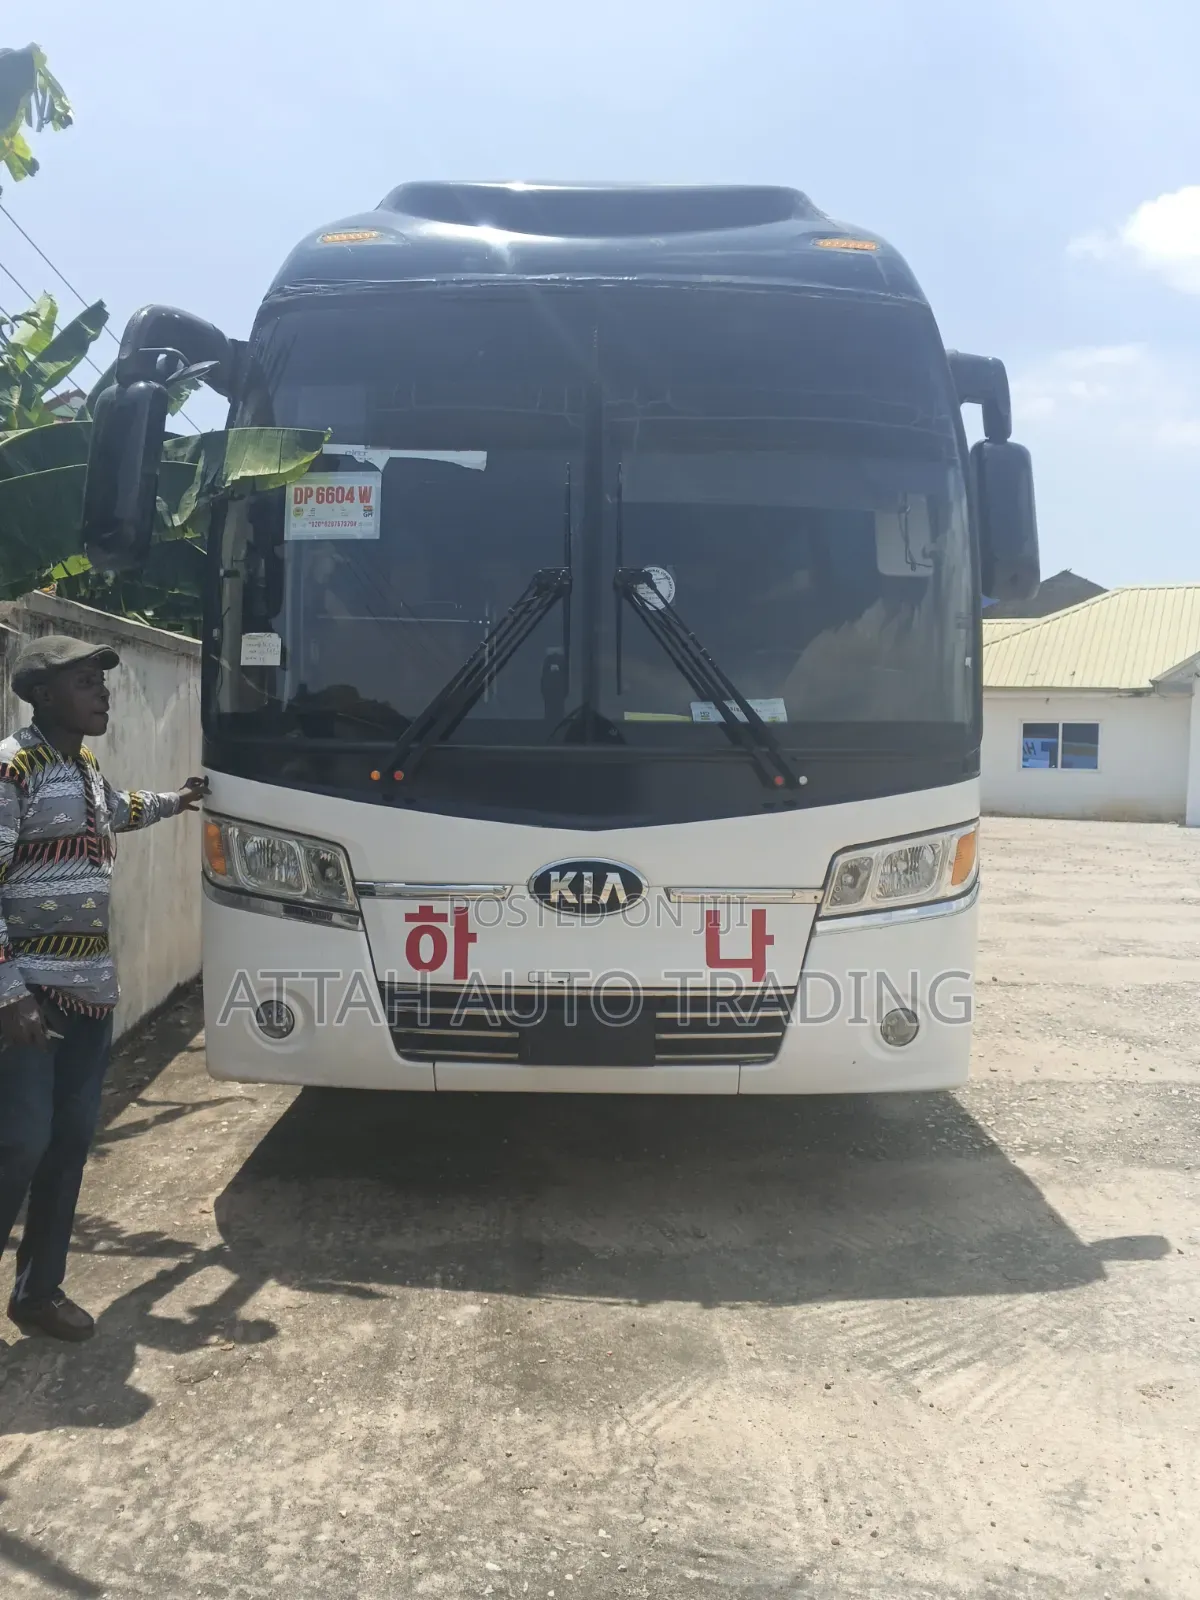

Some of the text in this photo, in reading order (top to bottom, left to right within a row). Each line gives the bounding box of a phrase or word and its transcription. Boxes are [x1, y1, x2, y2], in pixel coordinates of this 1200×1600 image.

[294, 486, 372, 505] DP 6604 W
[549, 871, 628, 904] KIA
[405, 905, 775, 983] 하 나
